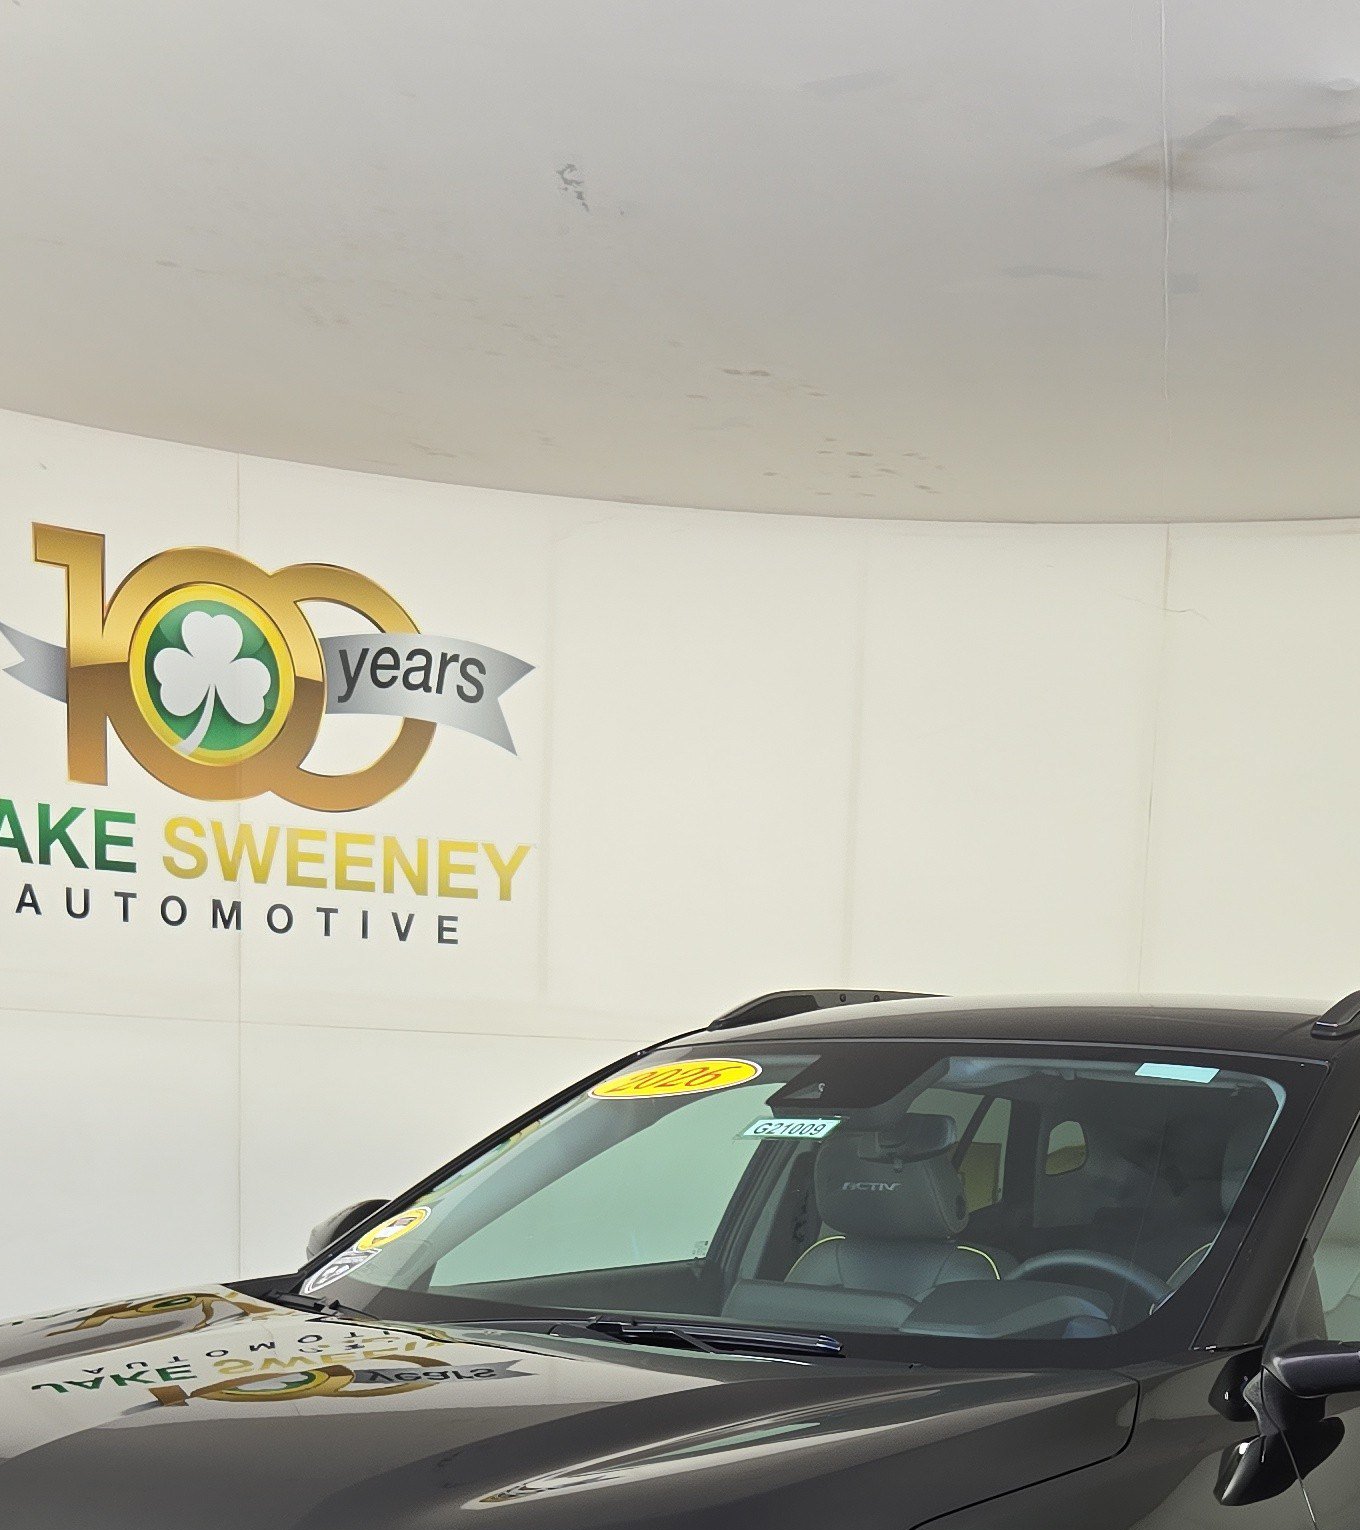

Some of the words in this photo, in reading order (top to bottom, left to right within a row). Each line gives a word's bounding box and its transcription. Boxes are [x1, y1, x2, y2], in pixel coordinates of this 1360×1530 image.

[31, 522, 437, 812] 100
[338, 645, 486, 703] years
[162, 817, 530, 901] SWEENEY
[15, 883, 459, 944] AUTOMOTIVE
[604, 1066, 741, 1093] 2026
[753, 1122, 826, 1135] G21009
